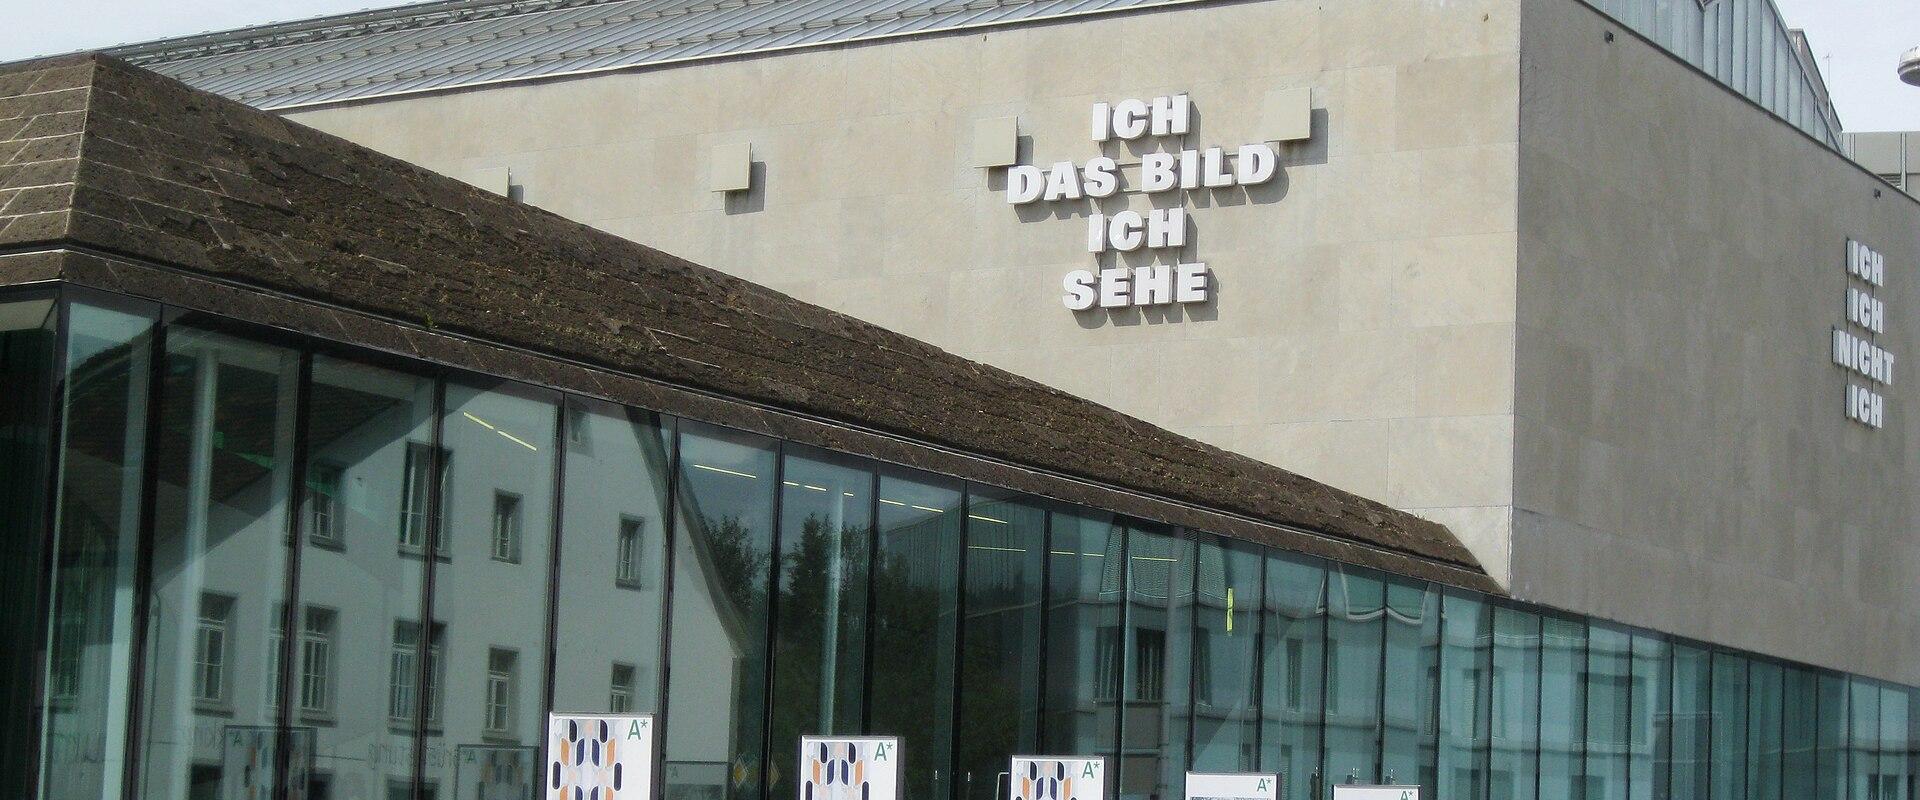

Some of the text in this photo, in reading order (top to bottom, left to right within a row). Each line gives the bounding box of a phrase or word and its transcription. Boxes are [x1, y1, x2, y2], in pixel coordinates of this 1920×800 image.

[1091, 95, 1190, 141] ICH
[1007, 144, 1277, 204] DAS BILD
[1088, 207, 1186, 252] ICH
[1063, 262, 1208, 310] SEHE
[1848, 240, 1883, 287] ICH
[1848, 288, 1883, 334] ICH
[1834, 330, 1894, 385] NICHT
[1847, 384, 1883, 428] ICH
